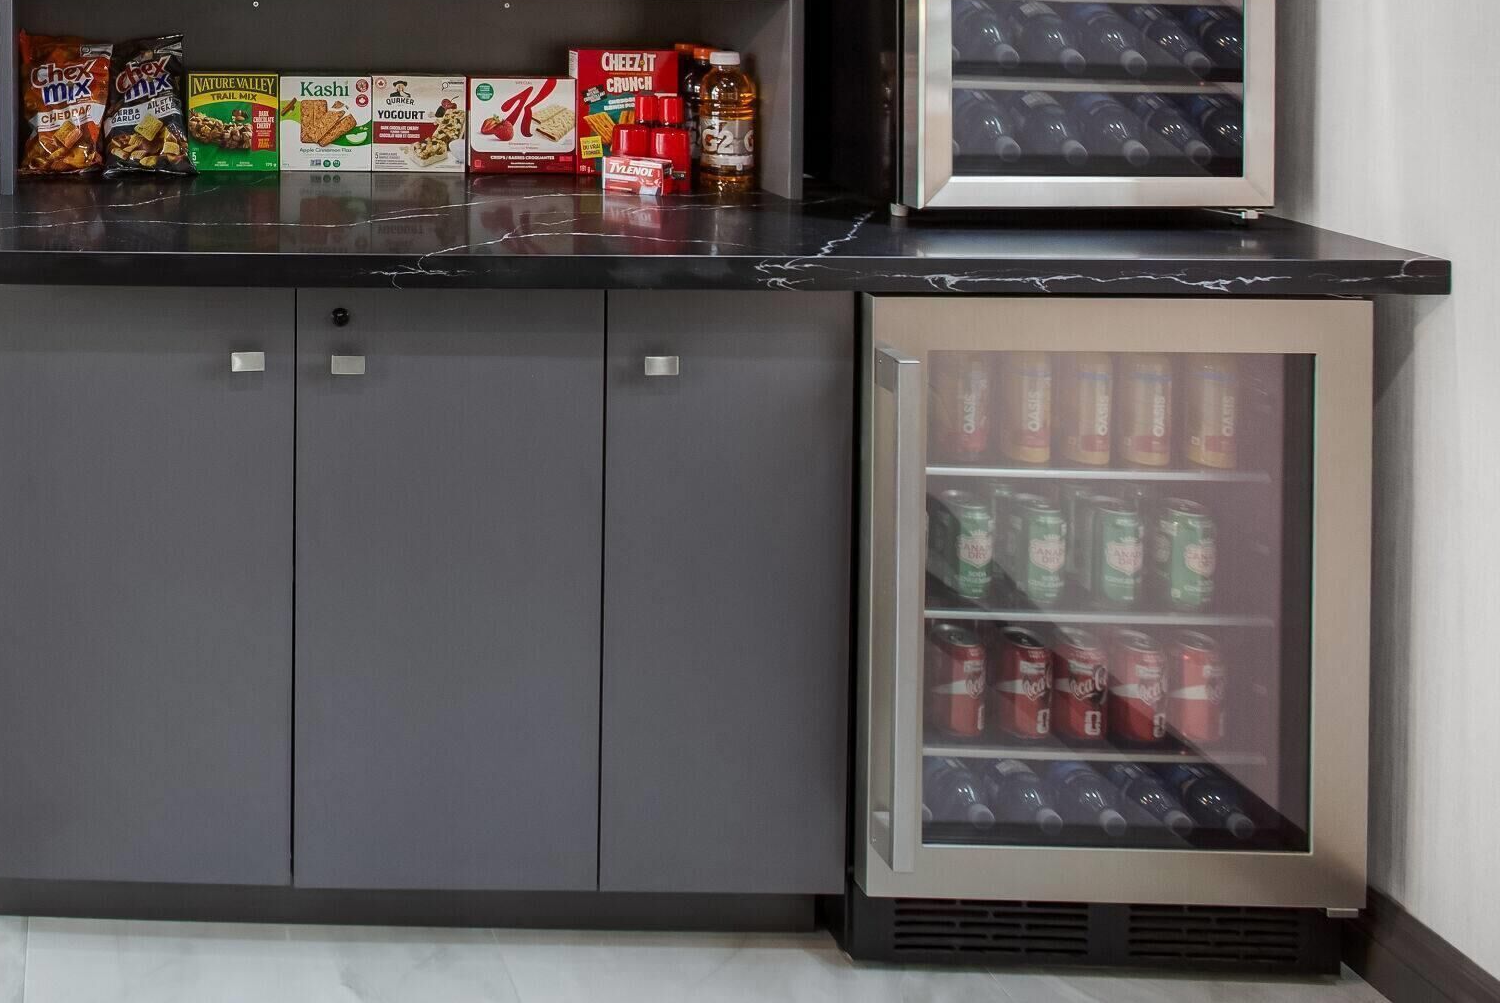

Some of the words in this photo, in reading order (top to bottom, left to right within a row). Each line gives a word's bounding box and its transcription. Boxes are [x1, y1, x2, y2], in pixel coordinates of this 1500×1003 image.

[31, 59, 97, 88] Chex
[116, 55, 171, 93] Chex
[193, 77, 236, 95] NATURE
[237, 77, 275, 96] VALLEY
[606, 76, 653, 93] CRUNCH
[43, 79, 91, 105] mix
[125, 73, 173, 103] mix
[211, 93, 237, 101] TRAIL
[239, 93, 257, 101] MIX
[300, 80, 350, 97] Kashi
[386, 97, 414, 106] QUAKER
[501, 79, 558, 138] K
[377, 110, 426, 120] YOGOURT
[702, 128, 734, 154] G2
[192, 152, 197, 161] 5
[609, 161, 654, 177] TYLENOL
[963, 393, 976, 434] OASIS
[1027, 389, 1041, 432] OASIS
[1095, 394, 1109, 437] OASIS
[1152, 395, 1165, 438] OASIS
[1222, 395, 1236, 437] OASIS
